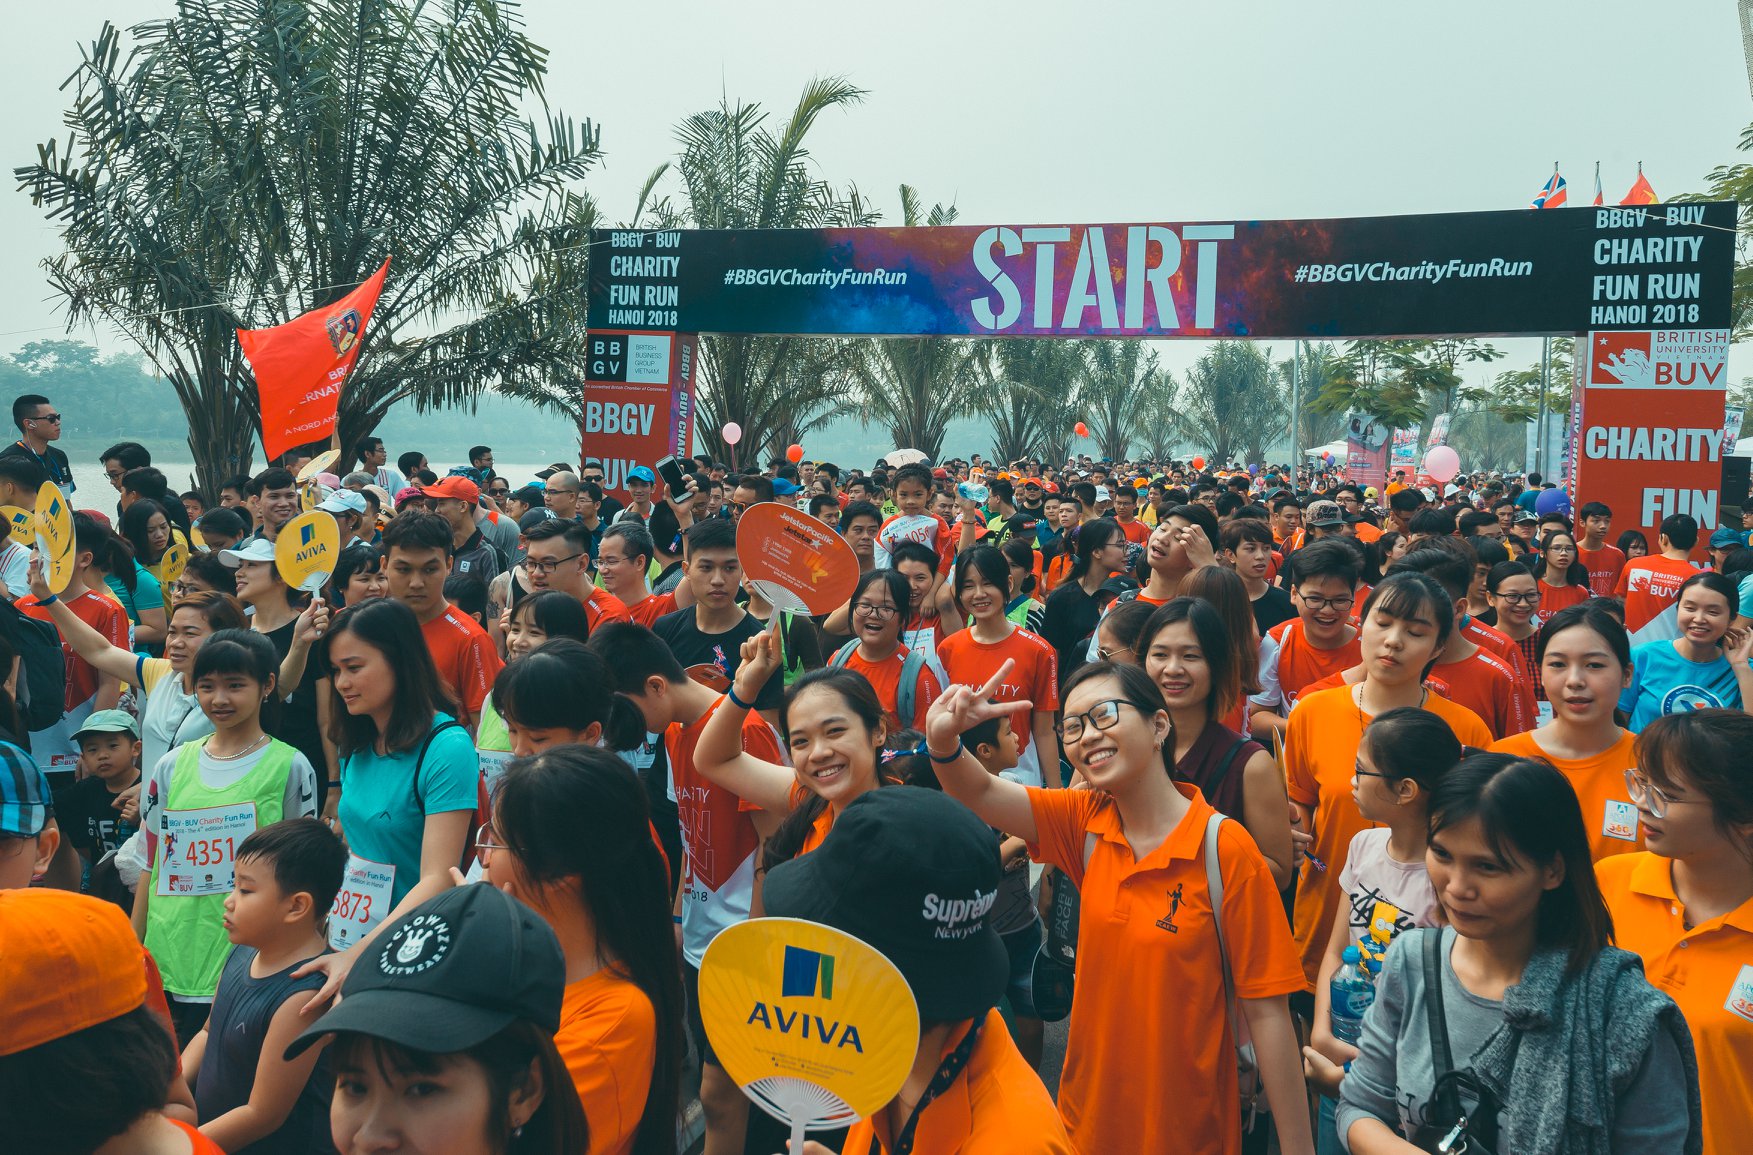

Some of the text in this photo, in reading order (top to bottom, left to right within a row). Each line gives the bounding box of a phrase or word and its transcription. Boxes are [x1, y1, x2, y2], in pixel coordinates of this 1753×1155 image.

[1596, 209, 1647, 228] BBGV
[1666, 206, 1705, 226] BUV
[611, 233, 644, 248] BBGV
[656, 233, 680, 247] BUV
[1594, 236, 1704, 265] CHARITY
[610, 256, 680, 277] CHARITY
[971, 224, 1234, 330] START
[1294, 258, 1532, 284] #BBGVCharityFunRun
[724, 268, 907, 290] #BBGVCharityFunRun
[1593, 273, 1700, 300] FUN RUN
[610, 285, 678, 306] FUN RUN
[608, 310, 678, 326] HANOI 2018
[1591, 304, 1699, 324] HANOI 2018
[1657, 332, 1726, 343] BRITISH
[682, 344, 690, 380] BBGV
[1655, 362, 1724, 385] BUV
[299, 382, 342, 404] RNAT
[679, 391, 688, 418] BUV
[293, 421, 320, 432] NORD
[586, 401, 655, 435] BBGV
[1585, 426, 1724, 462] CHARITY
[1641, 487, 1718, 530] FUN
[42, 510, 58, 541] AVIVA
[780, 512, 834, 544] JetstarPacific
[784, 526, 812, 544] Jetstar
[296, 543, 326, 563] AVIVA
[168, 561, 184, 575] AVIVA
[1654, 572, 1683, 582] BRITISH
[1650, 584, 1679, 598] BUV
[1032, 636, 1048, 650] British
[1486, 632, 1504, 646] British
[1496, 664, 1513, 682] British
[199, 817, 224, 825] Charity
[186, 837, 235, 867] 4351
[349, 866, 391, 882] Charity Fun Run
[333, 888, 372, 923] 5873
[392, 914, 450, 943] CLOWNZ
[1060, 896, 1072, 939] FACE
[747, 1001, 863, 1054] AVIVA
